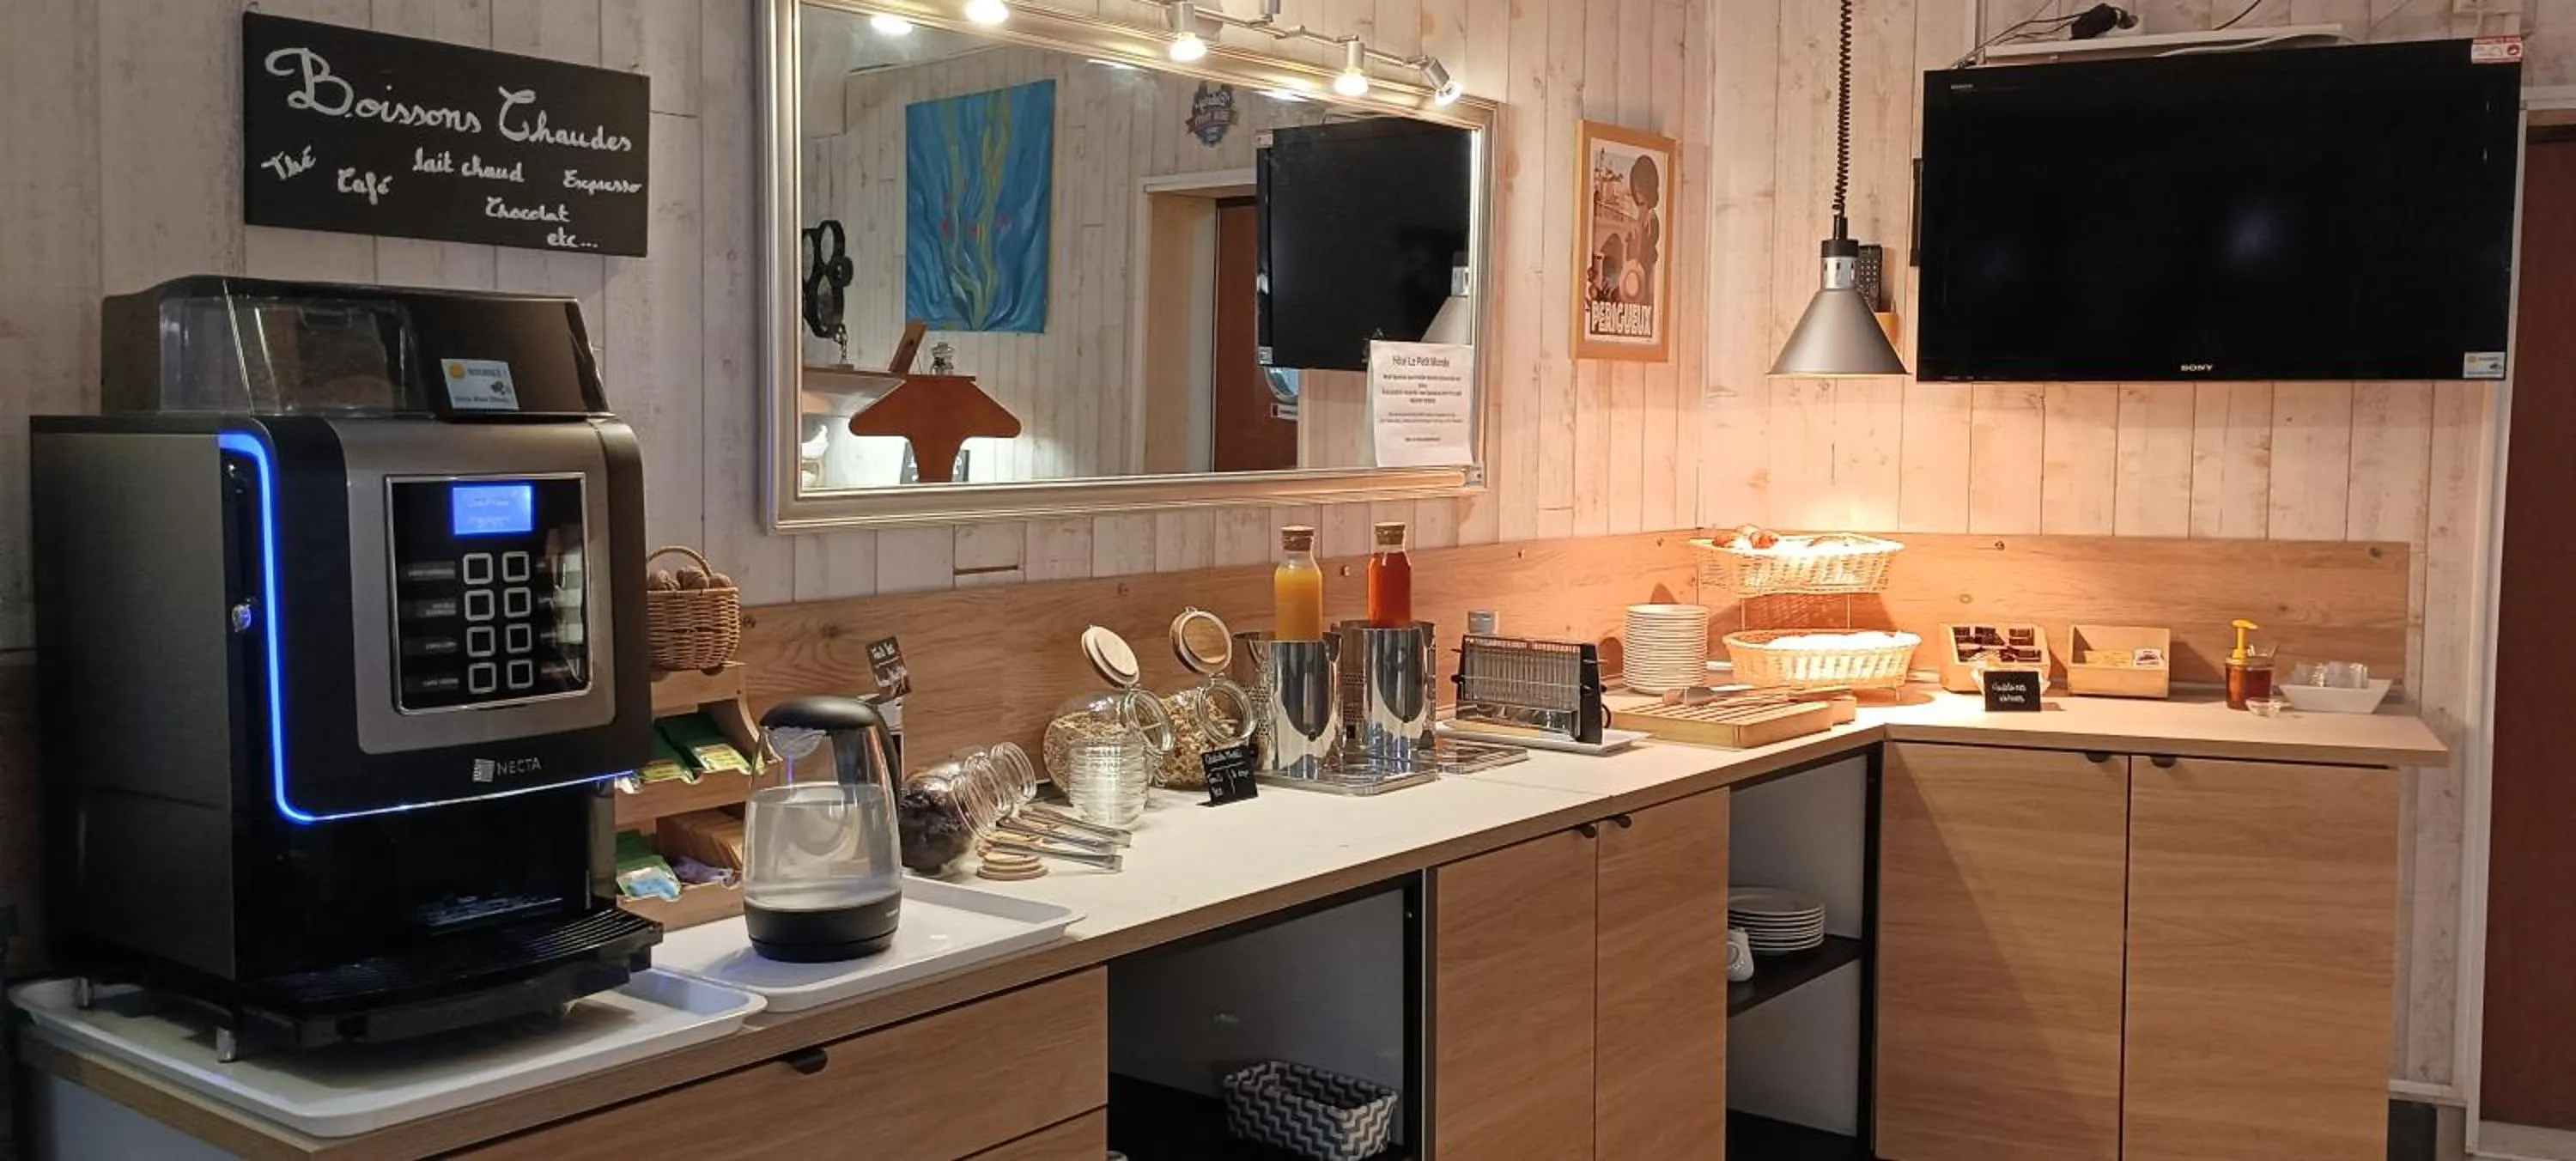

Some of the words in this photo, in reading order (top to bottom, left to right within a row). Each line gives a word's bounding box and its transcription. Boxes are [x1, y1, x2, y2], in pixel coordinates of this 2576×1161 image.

[264, 46, 483, 135] Boissons
[498, 85, 632, 153] Chaudes
[260, 144, 317, 181] Thé
[412, 147, 455, 173] lait
[460, 155, 526, 184] chaud
[337, 167, 394, 205] Café
[484, 196, 571, 223] Chocolat
[2180, 363, 2213, 372] SONY
[496, 757, 542, 776] NECTA
